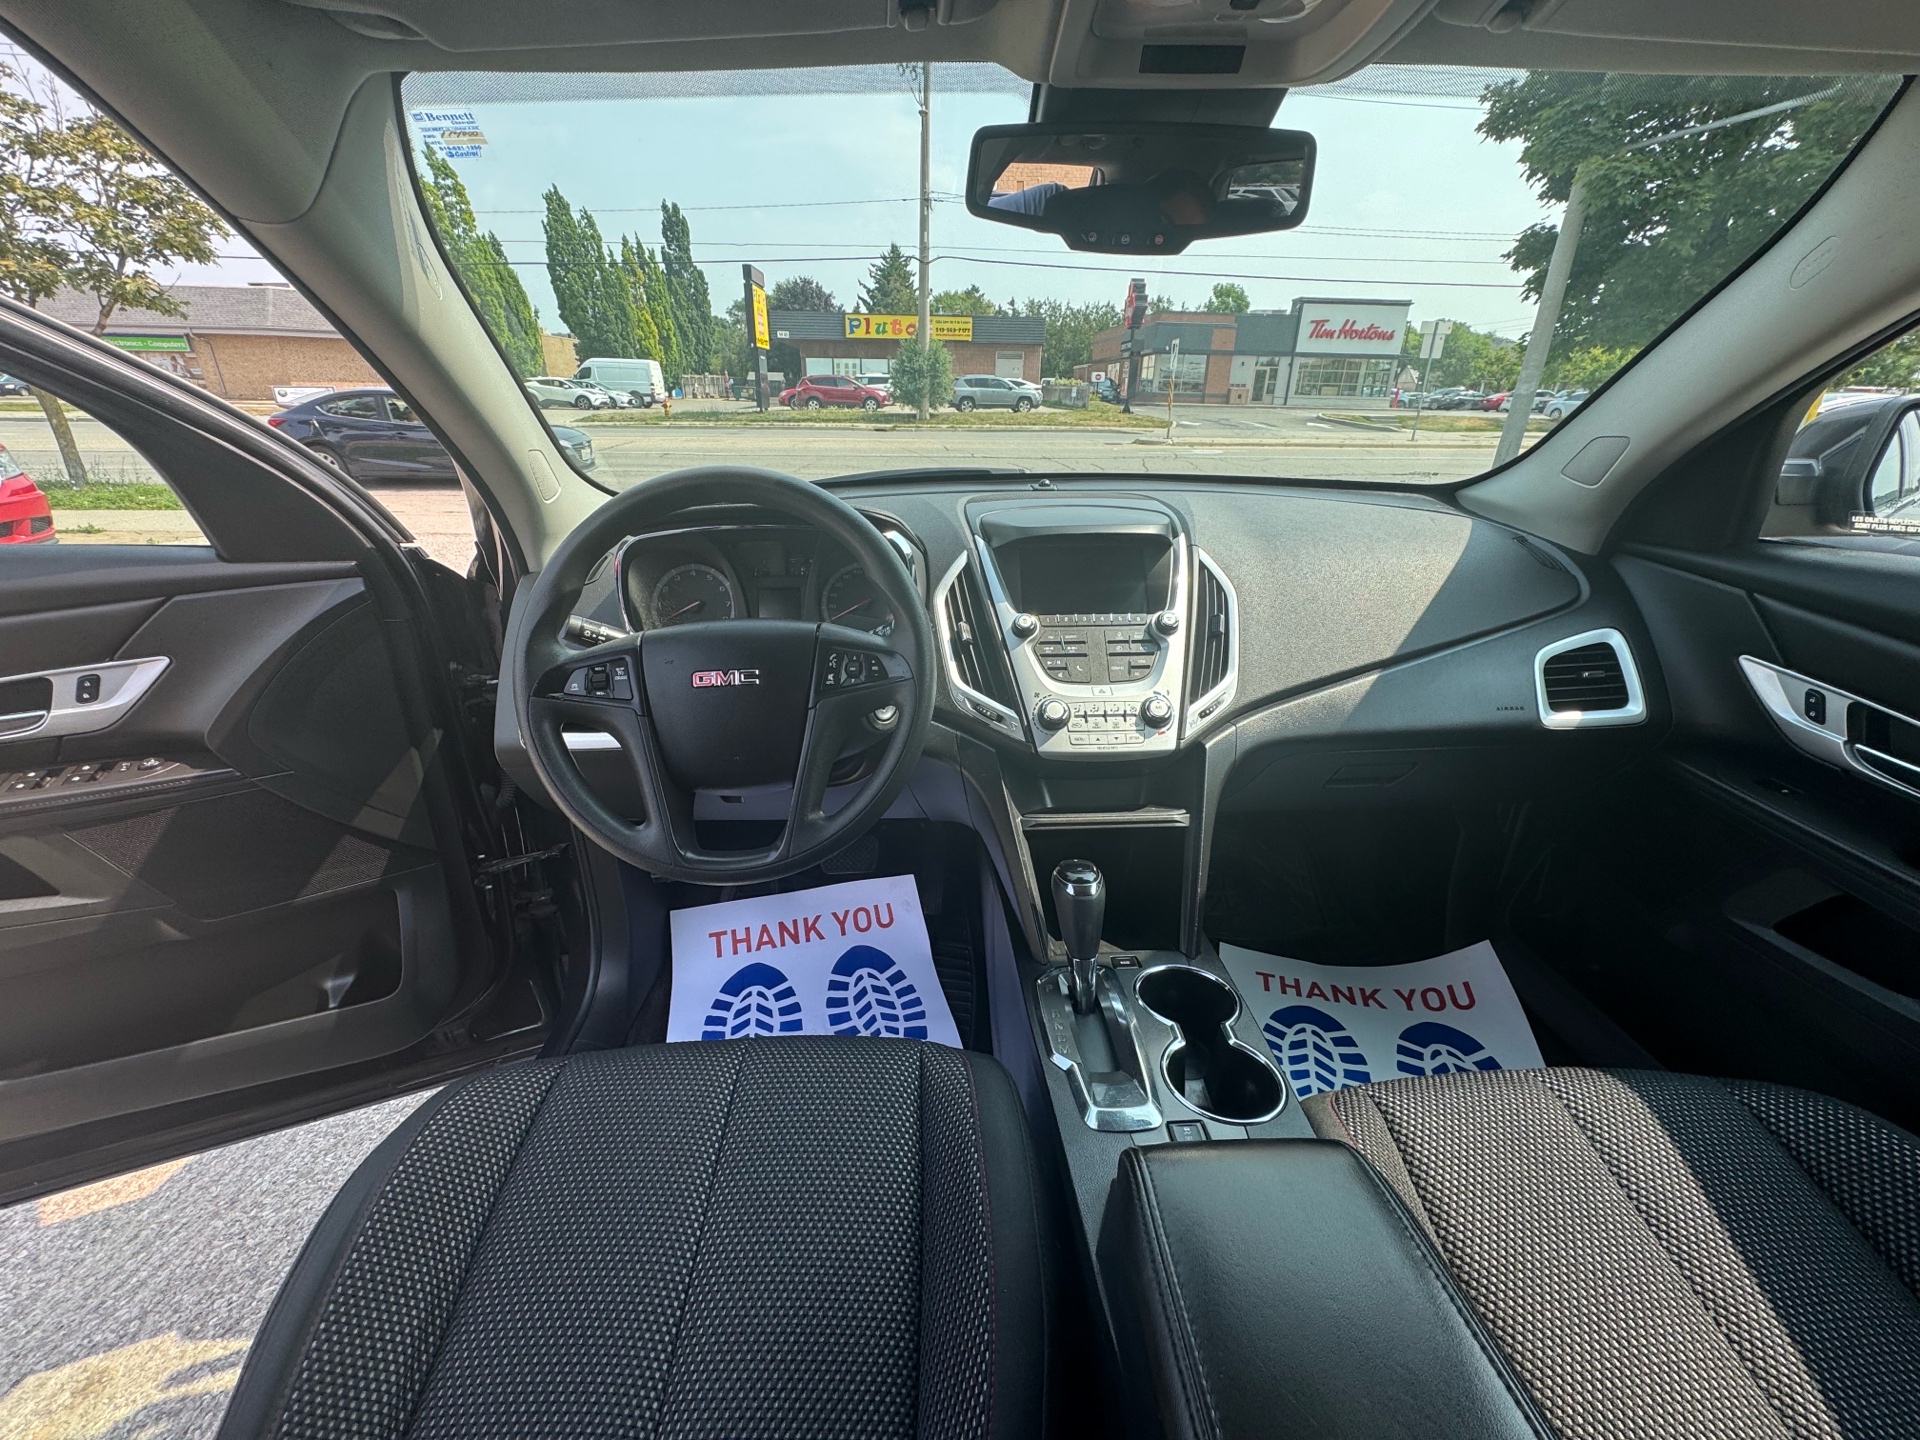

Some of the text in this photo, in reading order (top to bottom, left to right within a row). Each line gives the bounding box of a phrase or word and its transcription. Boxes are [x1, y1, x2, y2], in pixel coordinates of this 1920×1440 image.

[424, 112, 475, 121] Bennett
[1309, 319, 1396, 340] Tim Hortons
[147, 340, 187, 348] Computers
[692, 669, 760, 688] GMC
[708, 902, 895, 958] THANK YOU
[1255, 971, 1476, 1012] THANK YOU
